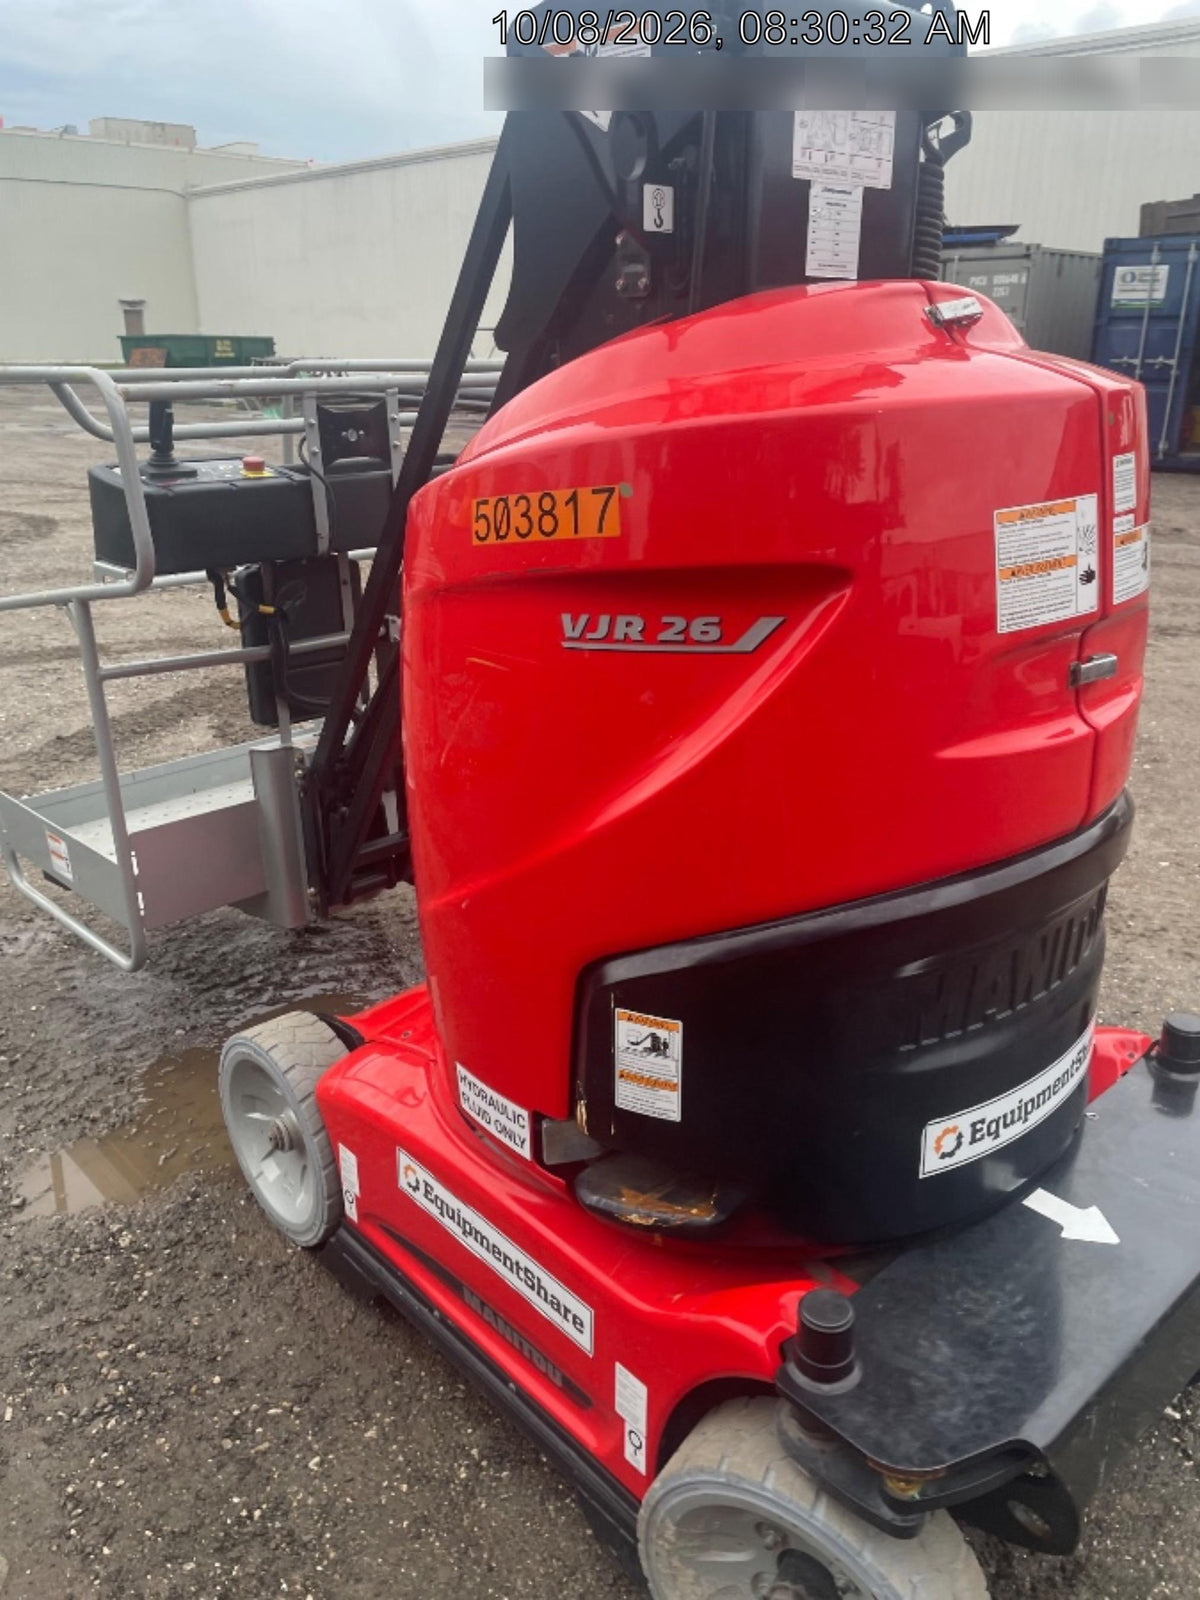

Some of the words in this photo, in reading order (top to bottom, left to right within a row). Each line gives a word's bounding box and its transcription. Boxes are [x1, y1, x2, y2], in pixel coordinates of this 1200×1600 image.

[474, 486, 616, 542] 503817
[561, 612, 645, 642] VJR
[657, 616, 722, 642] 26
[459, 1070, 526, 1130] HYDRAULIC
[461, 1091, 492, 1125] FLUID
[494, 1119, 526, 1150] ONLY
[422, 1179, 585, 1334] EquipmentShare
[462, 1285, 563, 1388] MANITOU
